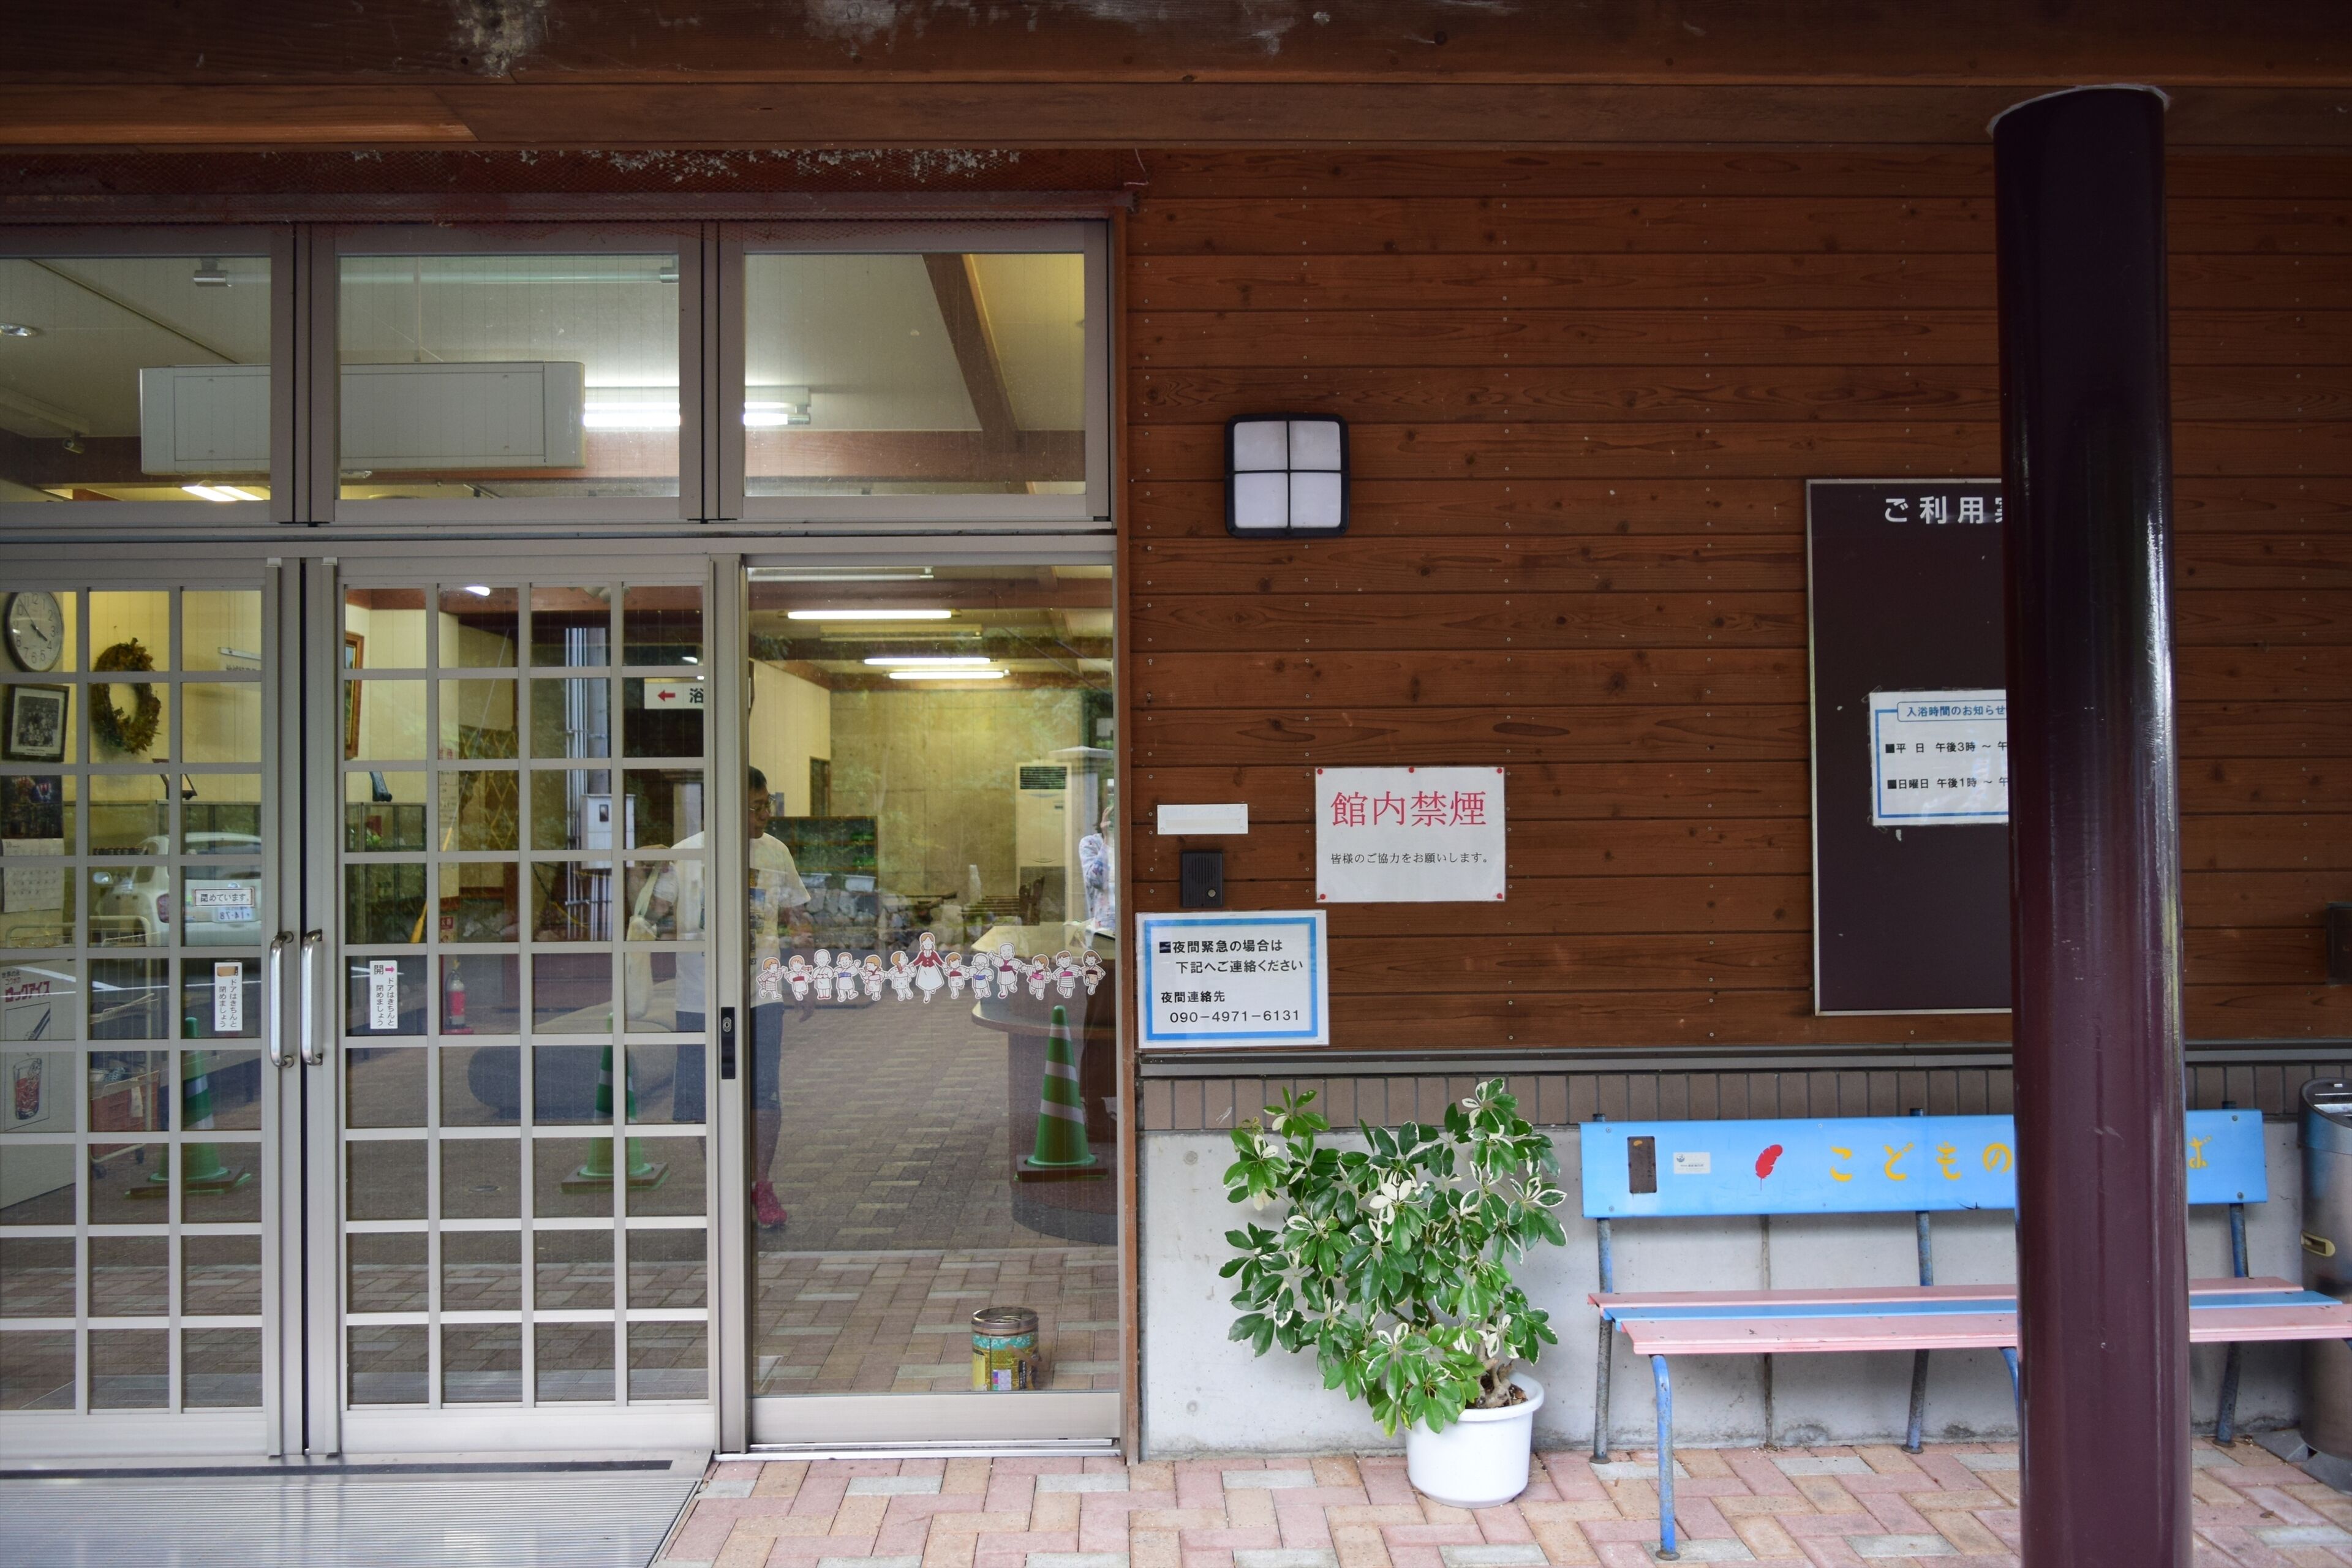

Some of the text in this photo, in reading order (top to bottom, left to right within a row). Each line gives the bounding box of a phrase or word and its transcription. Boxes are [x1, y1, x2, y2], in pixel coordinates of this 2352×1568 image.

[689, 688, 704, 703] 浴
[1906, 705, 2005, 717] 入浴時間のお知らせ
[1936, 742, 1976, 753] 午後3時
[1899, 778, 1929, 790] 日曜日
[1937, 778, 1977, 788] 午後1時
[1330, 790, 1487, 827] 館内禁煙
[1330, 851, 1488, 864] 皆様のご協力をお願いします。
[1172, 939, 1283, 954] 夜間緊急の場合は
[374, 965, 384, 975] 開
[1175, 959, 1303, 974] 下記へご連絡ください
[5, 981, 51, 1003] ロックアイス
[1161, 990, 1226, 1003] 夜間連絡先
[375, 984, 385, 1027] 閉めましょう
[386, 976, 395, 1027] ドアはきちんと
[1169, 1010, 1298, 1023] 090-4971-6131
[1830, 1141, 2013, 1182] こどもの
